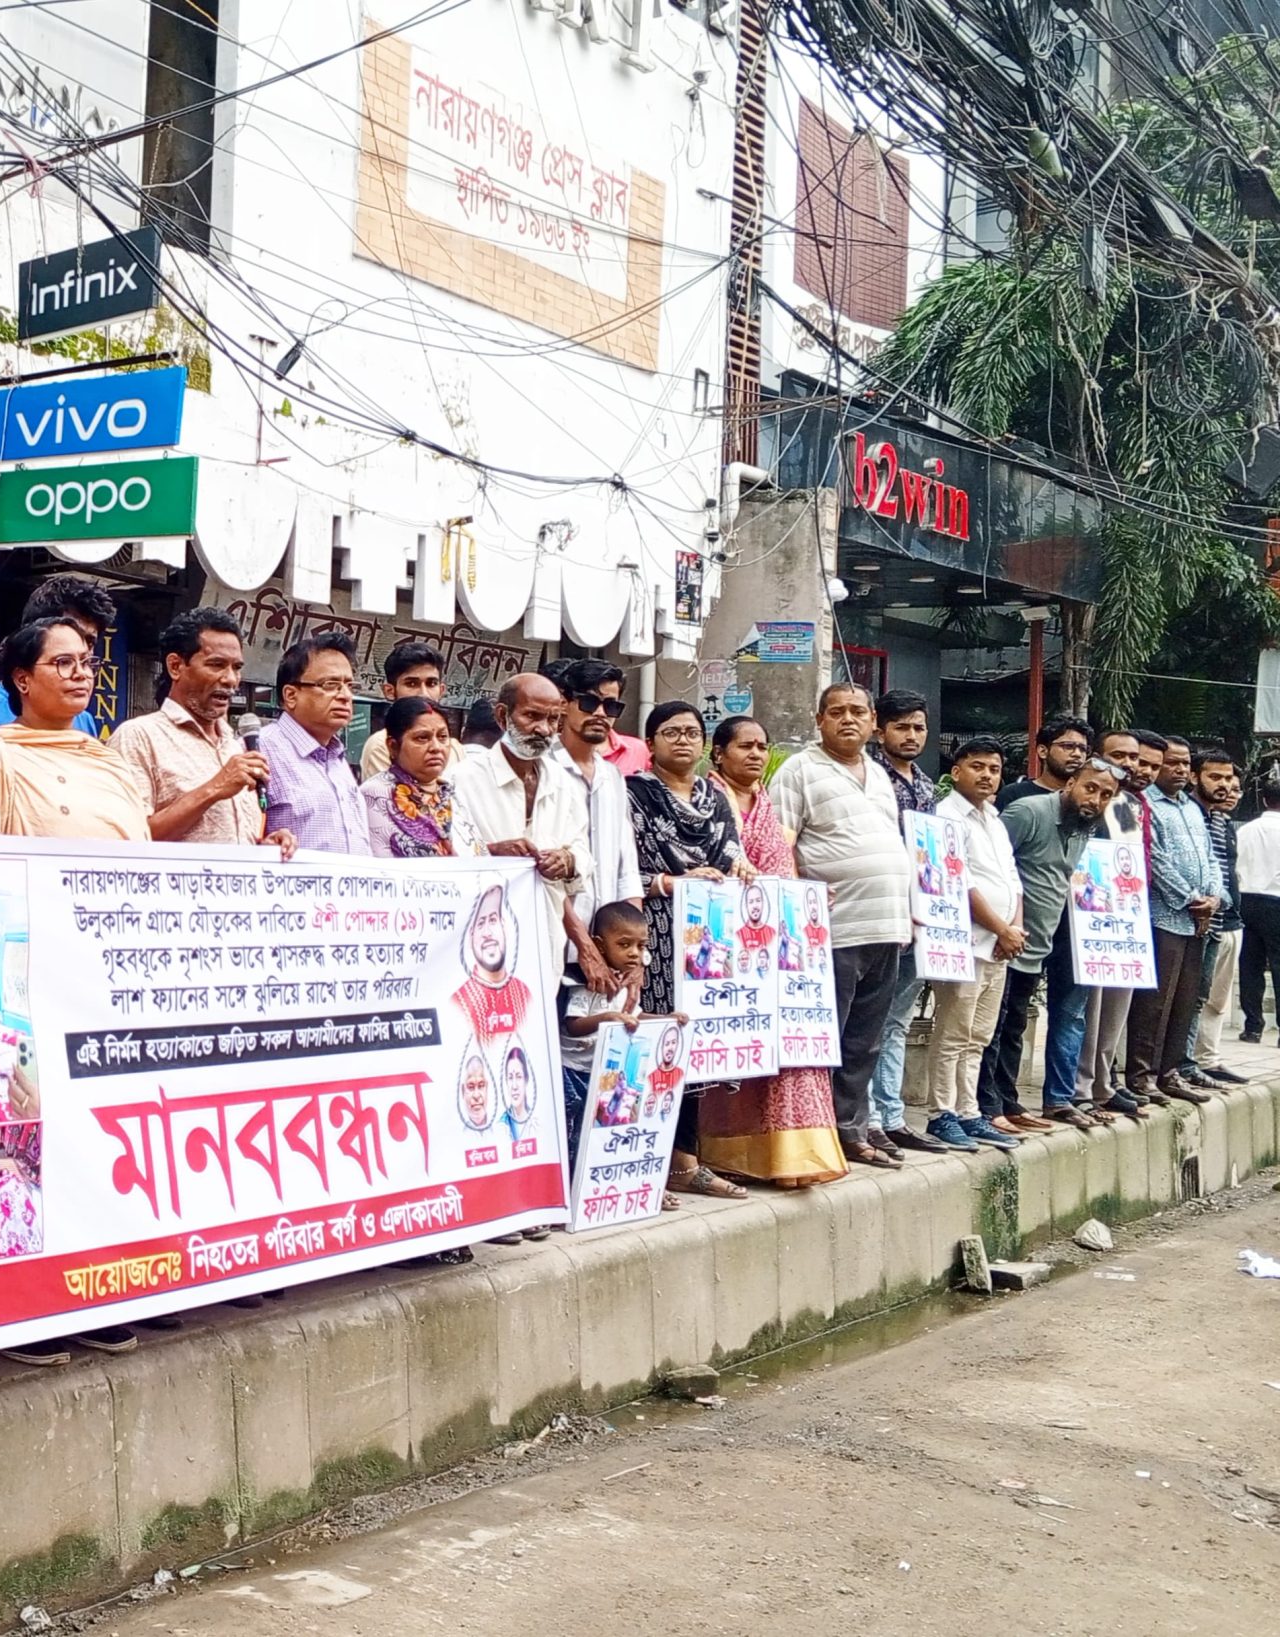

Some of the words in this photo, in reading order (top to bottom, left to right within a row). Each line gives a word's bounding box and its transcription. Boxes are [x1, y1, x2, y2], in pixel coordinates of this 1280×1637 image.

[414, 68, 533, 179] নারায়ণগঞ্জ
[541, 143, 584, 203] প্রেস
[590, 162, 629, 226] ক্লাব
[454, 166, 511, 224] স্থাপিত
[31, 258, 138, 316] Infinix
[16, 394, 147, 446] vivo
[25, 476, 151, 526] oppo
[61, 868, 161, 895] নারায়ণগঞ্জের
[166, 865, 257, 900] আড়াইহাজার
[261, 867, 333, 898] উপজেলার
[73, 903, 142, 941] উলুকান্দি
[146, 908, 183, 934] গ্রামে
[189, 904, 252, 941] যৌতুকের
[257, 904, 306, 933] দাবিতে
[311, 902, 339, 933] ঐশী
[344, 909, 389, 933] পোদ্দার
[394, 907, 424, 937] (১৯)
[429, 910, 456, 933] নামে
[102, 946, 172, 984] গৃহবধূকে
[177, 945, 222, 981] নৃশংস
[227, 945, 265, 969] ভাবে
[269, 944, 325, 972] শ্বাসরুদ্ধ
[329, 944, 360, 966] করে
[363, 942, 405, 965] হত্যার
[409, 941, 428, 964] পর
[1081, 939, 1148, 955] হত্যাকারীর
[110, 987, 146, 1014] লাশ
[150, 985, 210, 1013] ফ্যানের
[214, 985, 248, 1009] সঙ্গে
[252, 975, 300, 1015] ঝুলিয়ে
[305, 978, 337, 1004] রাখে
[342, 978, 368, 1002] তার
[779, 1002, 832, 1023] হত্যাকারীর
[76, 1036, 102, 1067] এই
[103, 1032, 142, 1065] নির্মম
[218, 1026, 259, 1057] জড়িত
[260, 1030, 293, 1051] সকল
[295, 1019, 355, 1048] আসামীদের
[392, 1012, 433, 1039] দাবীতে
[690, 1039, 729, 1075] ফাঁসি
[90, 1071, 433, 1221] মানববন্ধন
[590, 1152, 665, 1183] হত্যাকারীর
[583, 1186, 621, 1223] ফাঁসি
[187, 1233, 259, 1279] নিহতের
[264, 1216, 324, 1259] পরিবার
[329, 1204, 356, 1248] বর্গ
[361, 1214, 376, 1238] ও
[380, 1184, 463, 1236] এলাকাবাসী
